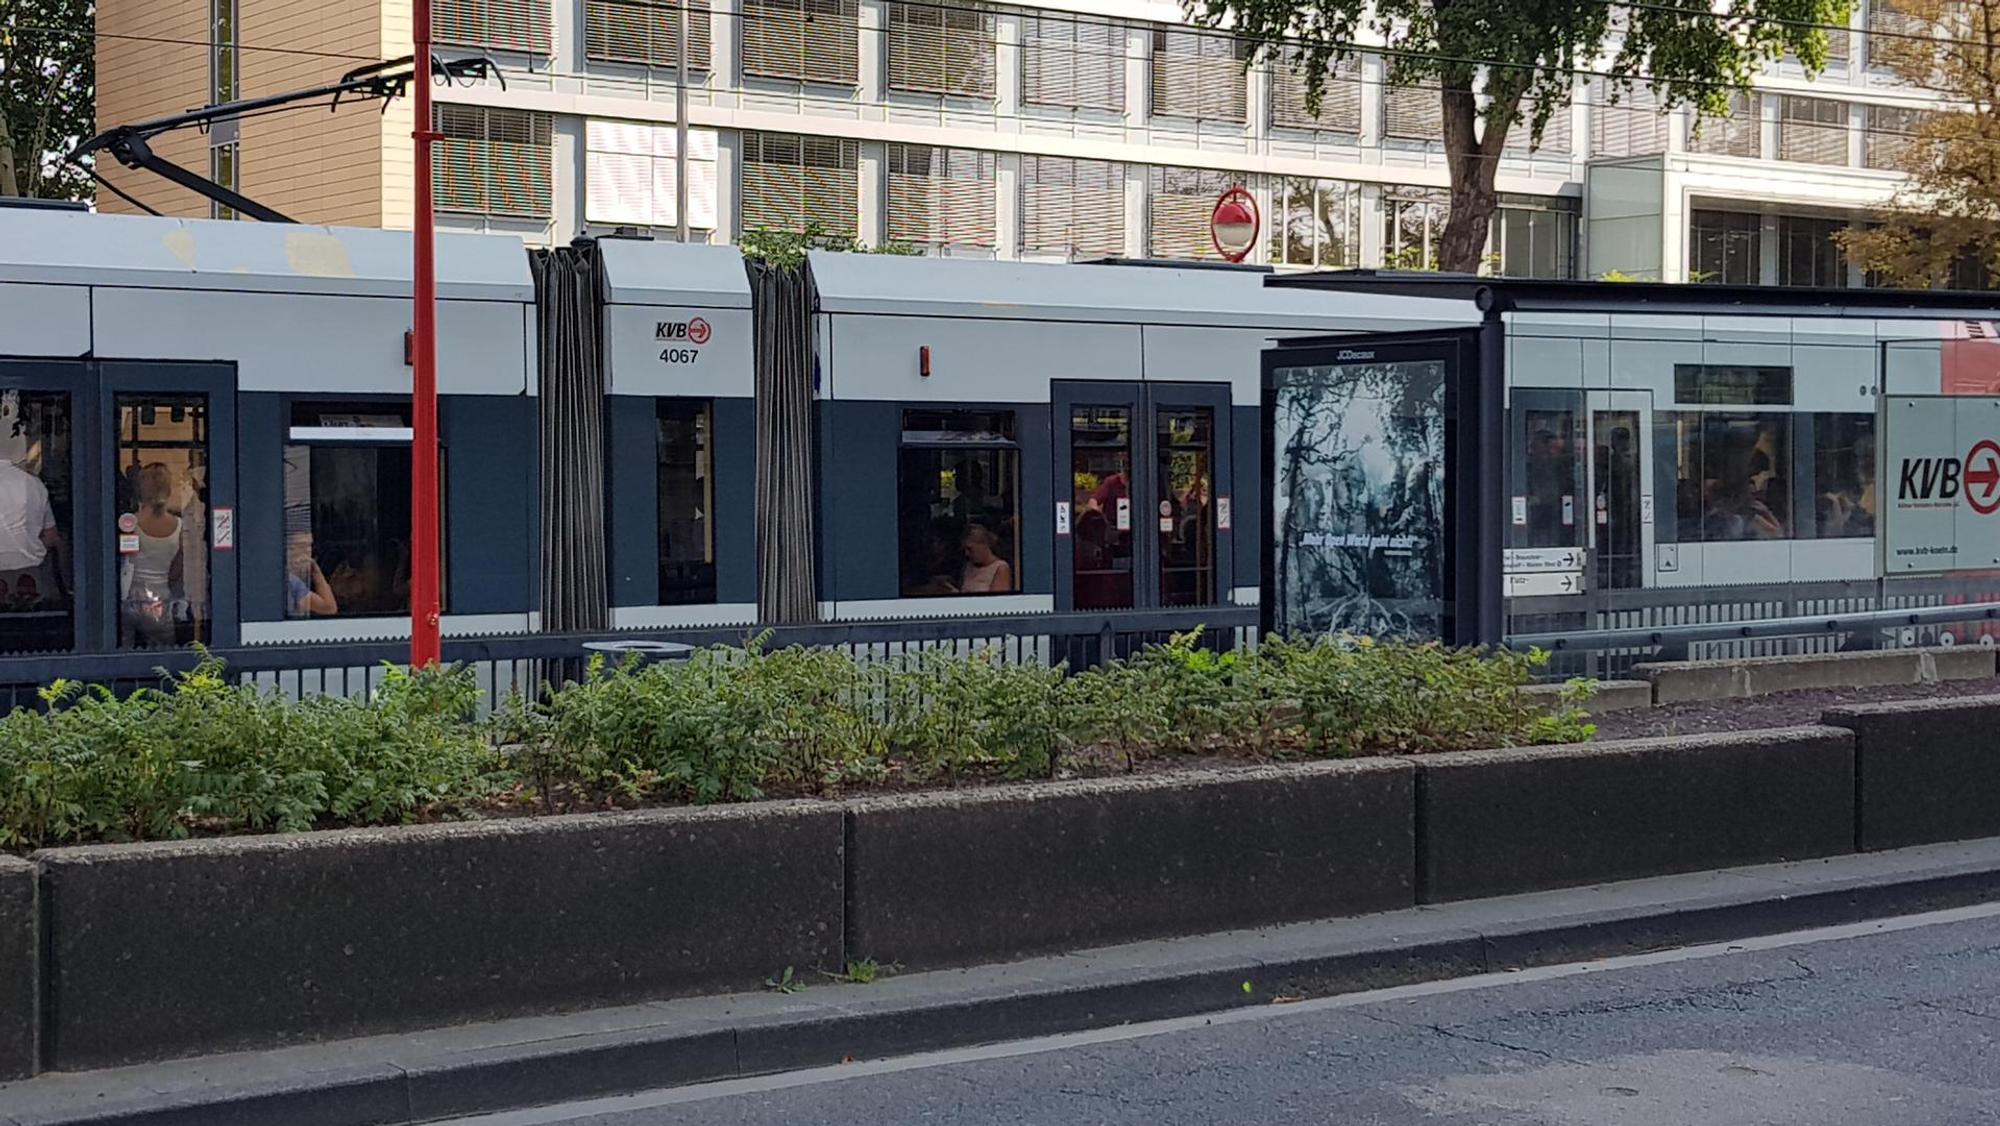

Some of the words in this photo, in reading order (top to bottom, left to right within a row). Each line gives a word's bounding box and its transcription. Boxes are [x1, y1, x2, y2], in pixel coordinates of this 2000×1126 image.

[656, 322, 687, 338] KVB
[659, 348, 699, 364] 4067
[1898, 457, 1962, 500] KVB
